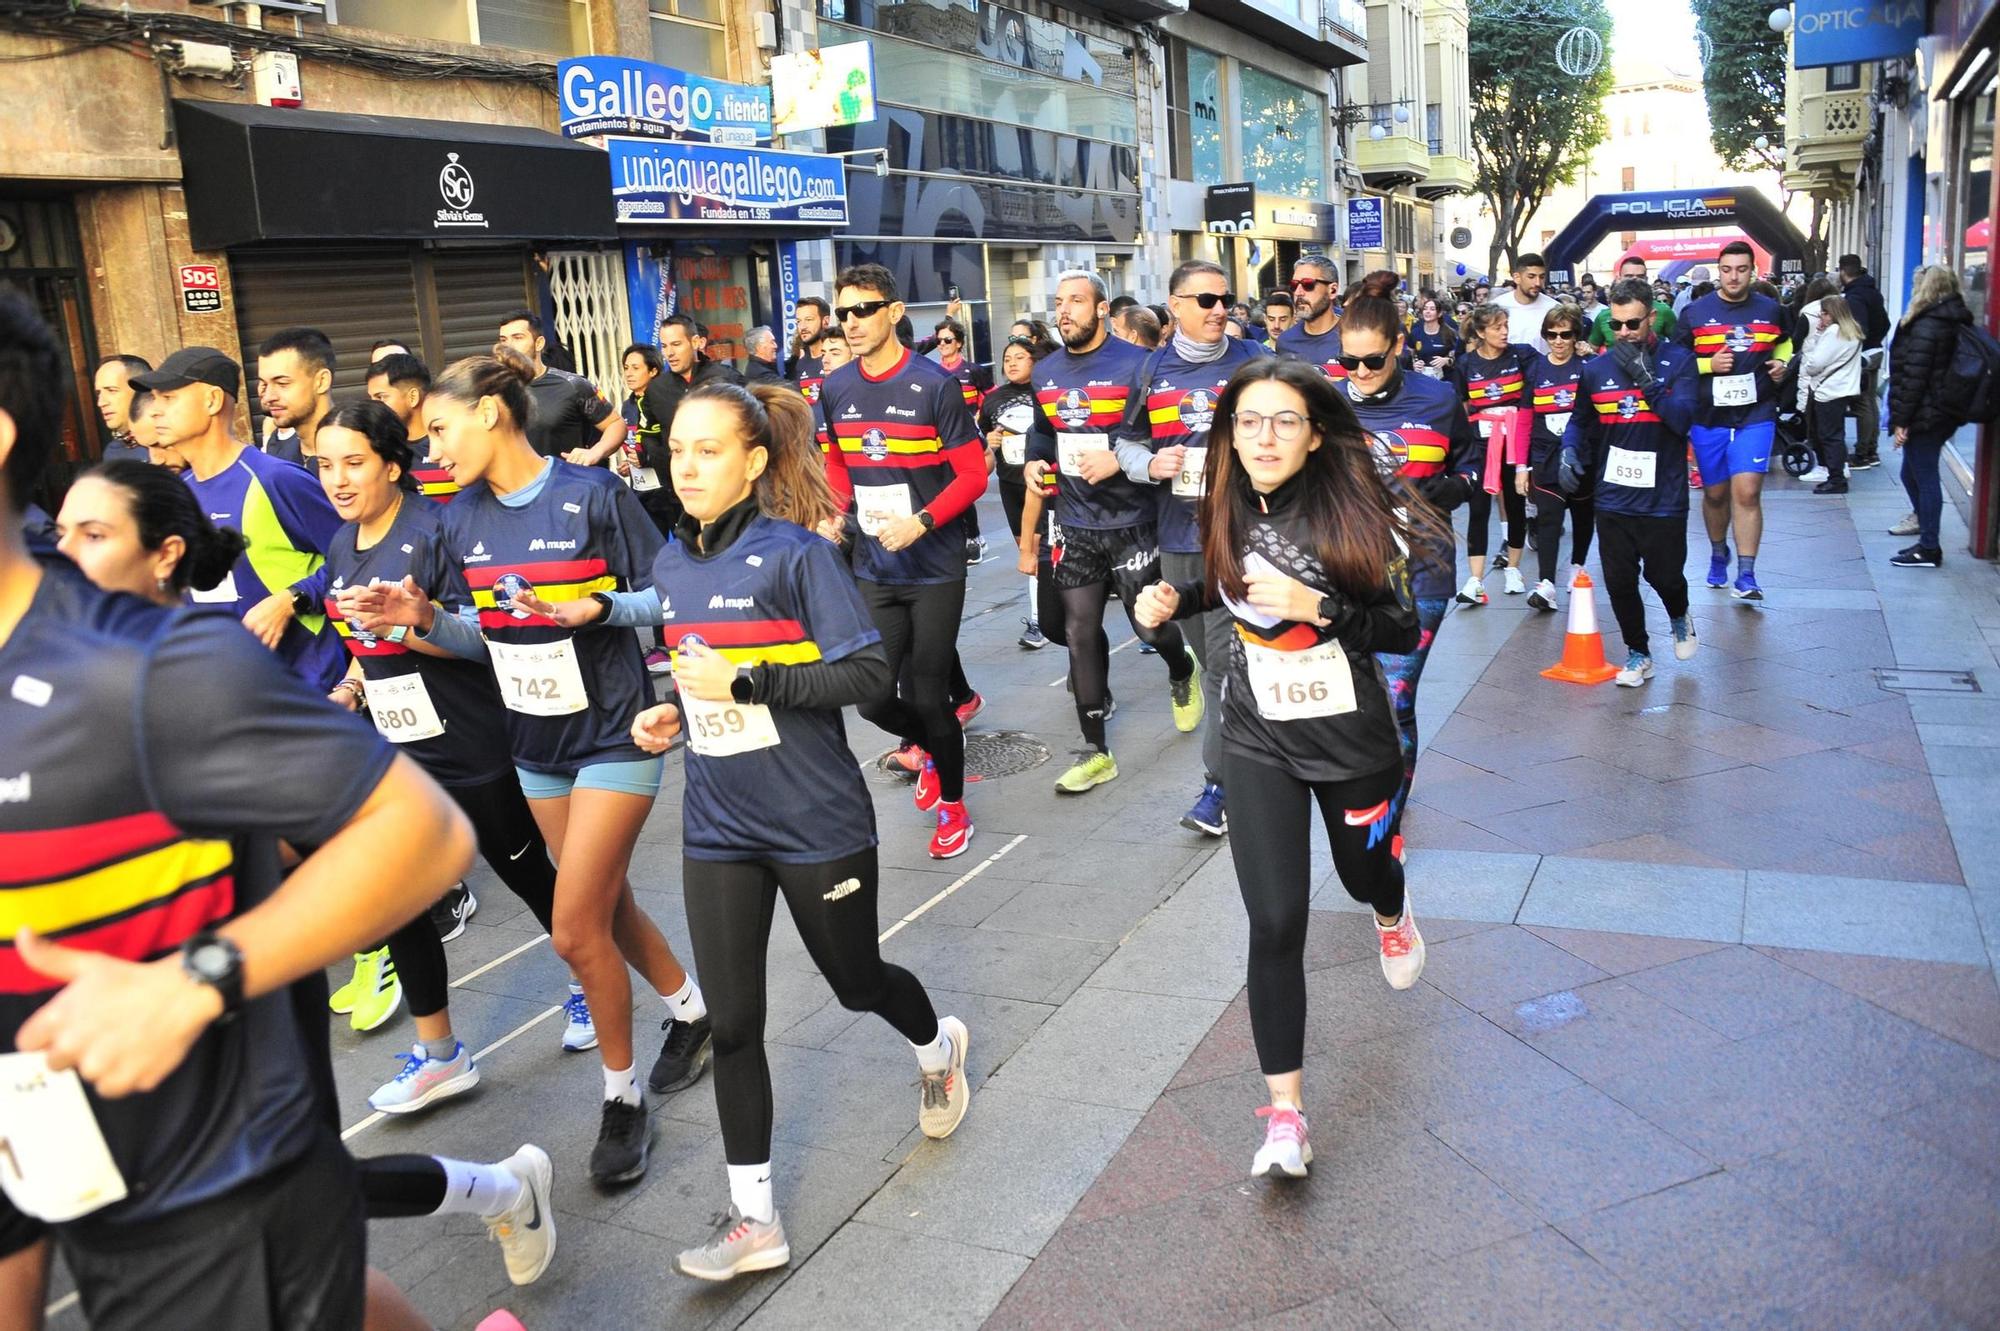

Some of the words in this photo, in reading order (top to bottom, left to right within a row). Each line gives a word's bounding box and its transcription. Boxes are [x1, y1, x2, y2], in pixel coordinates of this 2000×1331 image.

[569, 119, 628, 135] tratamientos
[629, 120, 641, 129] de
[643, 123, 665, 134] agua
[443, 167, 470, 202] SG
[622, 148, 836, 208] uniaguagallego.com
[437, 209, 462, 221] Silvia's
[463, 210, 484, 221] Gems
[701, 206, 736, 219] Fundada
[738, 209, 748, 219] en
[750, 208, 771, 220] 1.995
[1611, 198, 1707, 215] POLICIA
[1668, 208, 1735, 219] NACIONAL
[183, 269, 217, 286] SDS
[1724, 389, 1749, 399] 479
[1616, 465, 1643, 479] 639
[463, 554, 492, 564] Santander
[547, 539, 576, 551] mupol
[725, 595, 754, 610] mupol
[511, 676, 561, 699] 742
[1268, 681, 1328, 704] 166
[377, 708, 418, 729] 680
[695, 709, 745, 737] 659
